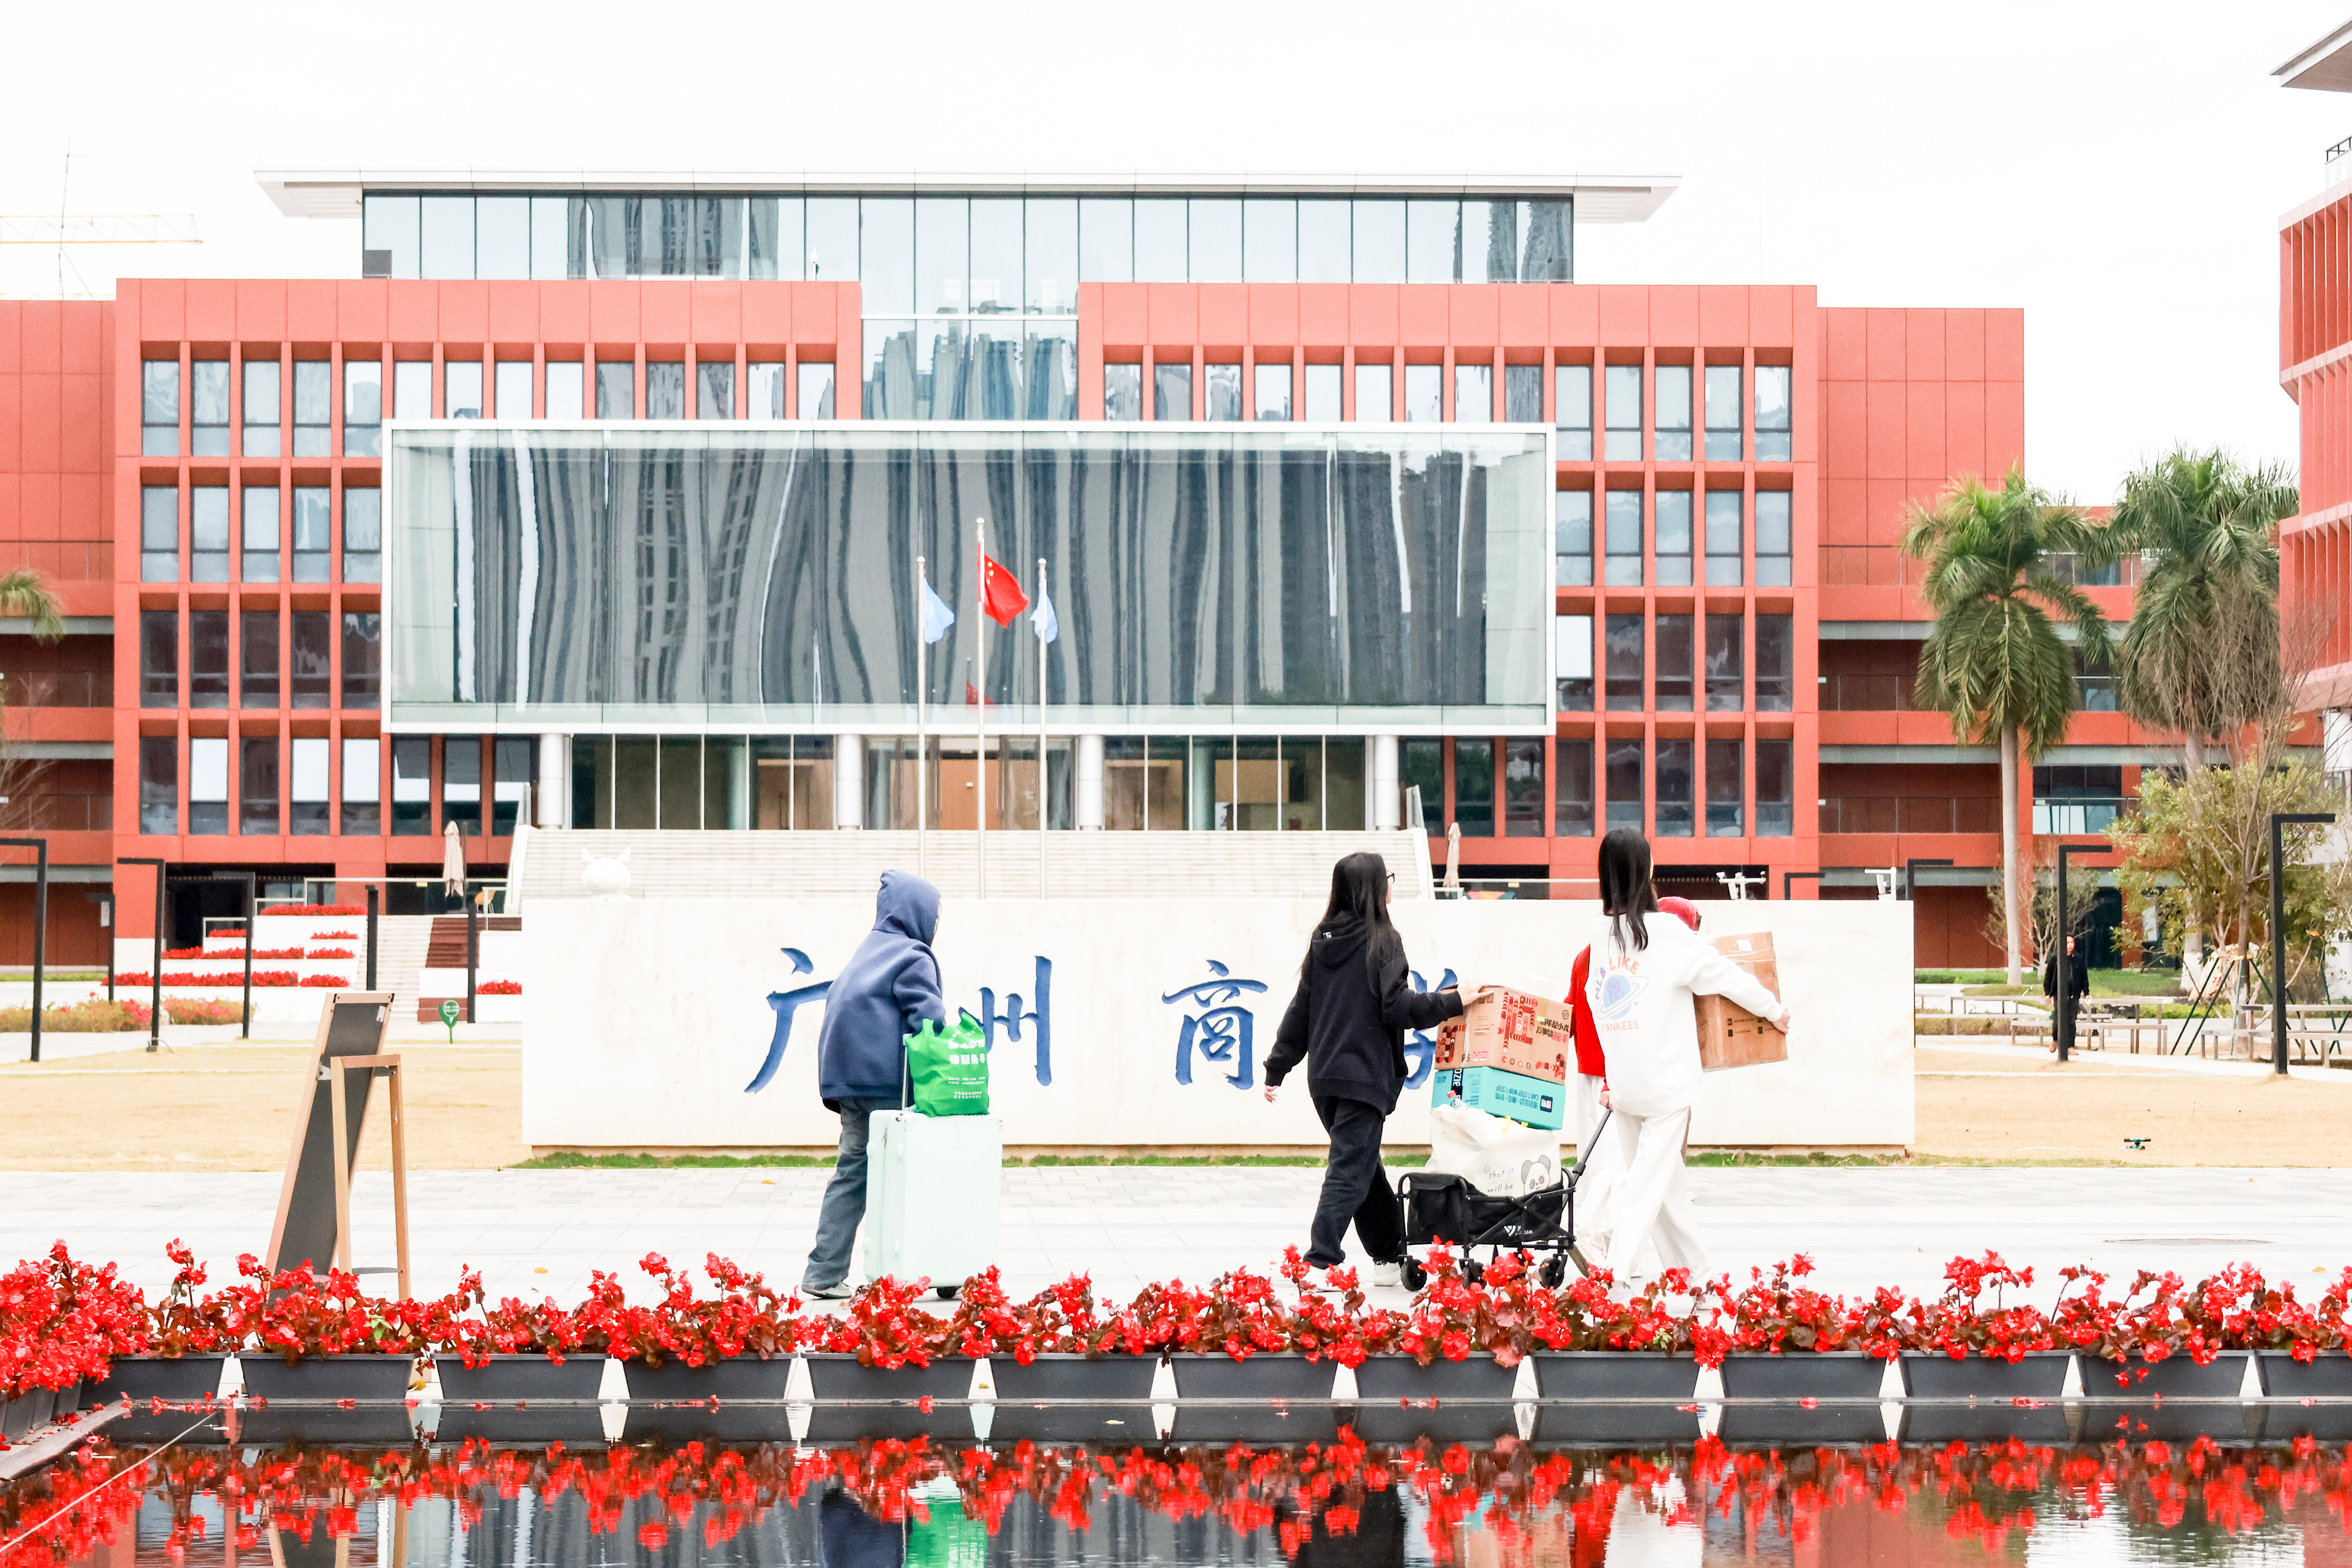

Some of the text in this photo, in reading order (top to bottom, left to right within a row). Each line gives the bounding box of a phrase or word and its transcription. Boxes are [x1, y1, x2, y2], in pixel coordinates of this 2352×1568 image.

[1609, 956, 1639, 975] LIKE
[1601, 1020, 1638, 1033] YANKEES
[1489, 1170, 1505, 1179] that
[1487, 1183, 1502, 1192] will
